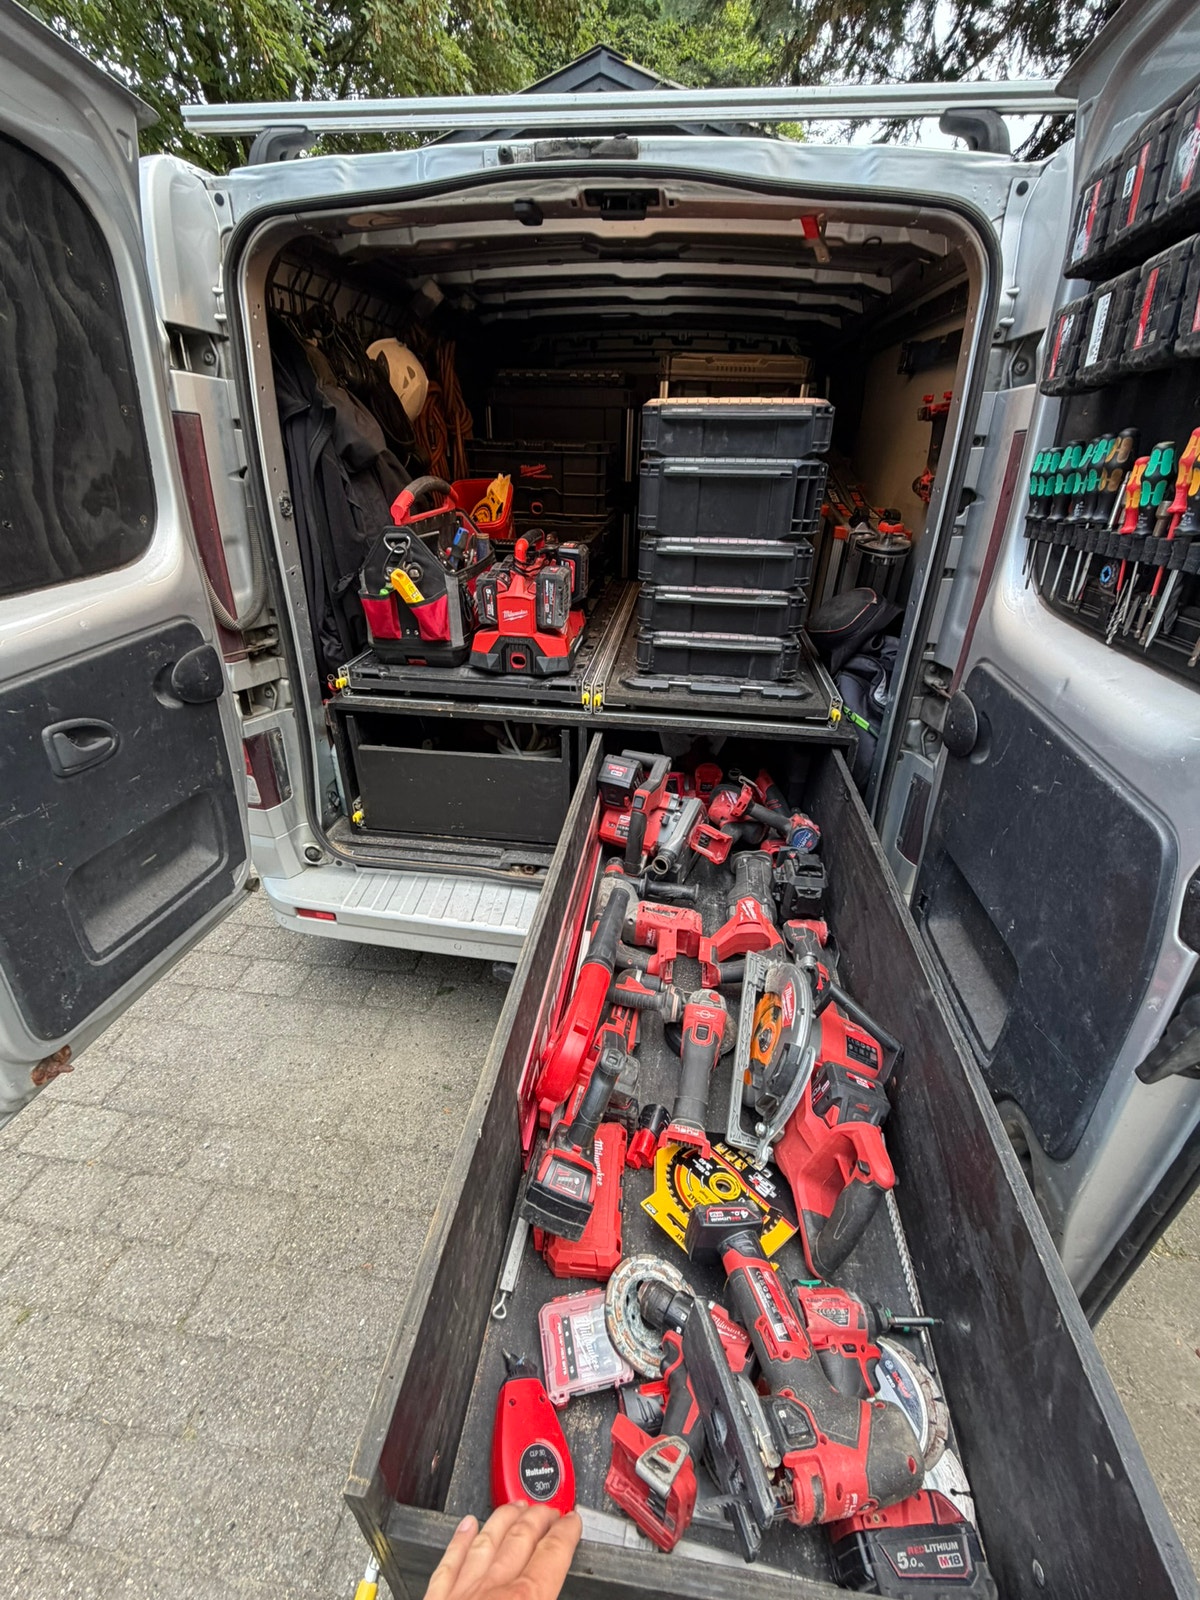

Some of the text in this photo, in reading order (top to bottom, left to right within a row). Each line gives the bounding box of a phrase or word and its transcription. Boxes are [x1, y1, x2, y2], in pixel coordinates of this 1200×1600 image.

[594, 1138, 605, 1187] Milwaukee
[525, 1467, 554, 1477] Hultafors
[906, 1541, 959, 1555] REDLITHIUM
[938, 1554, 962, 1568] M18
